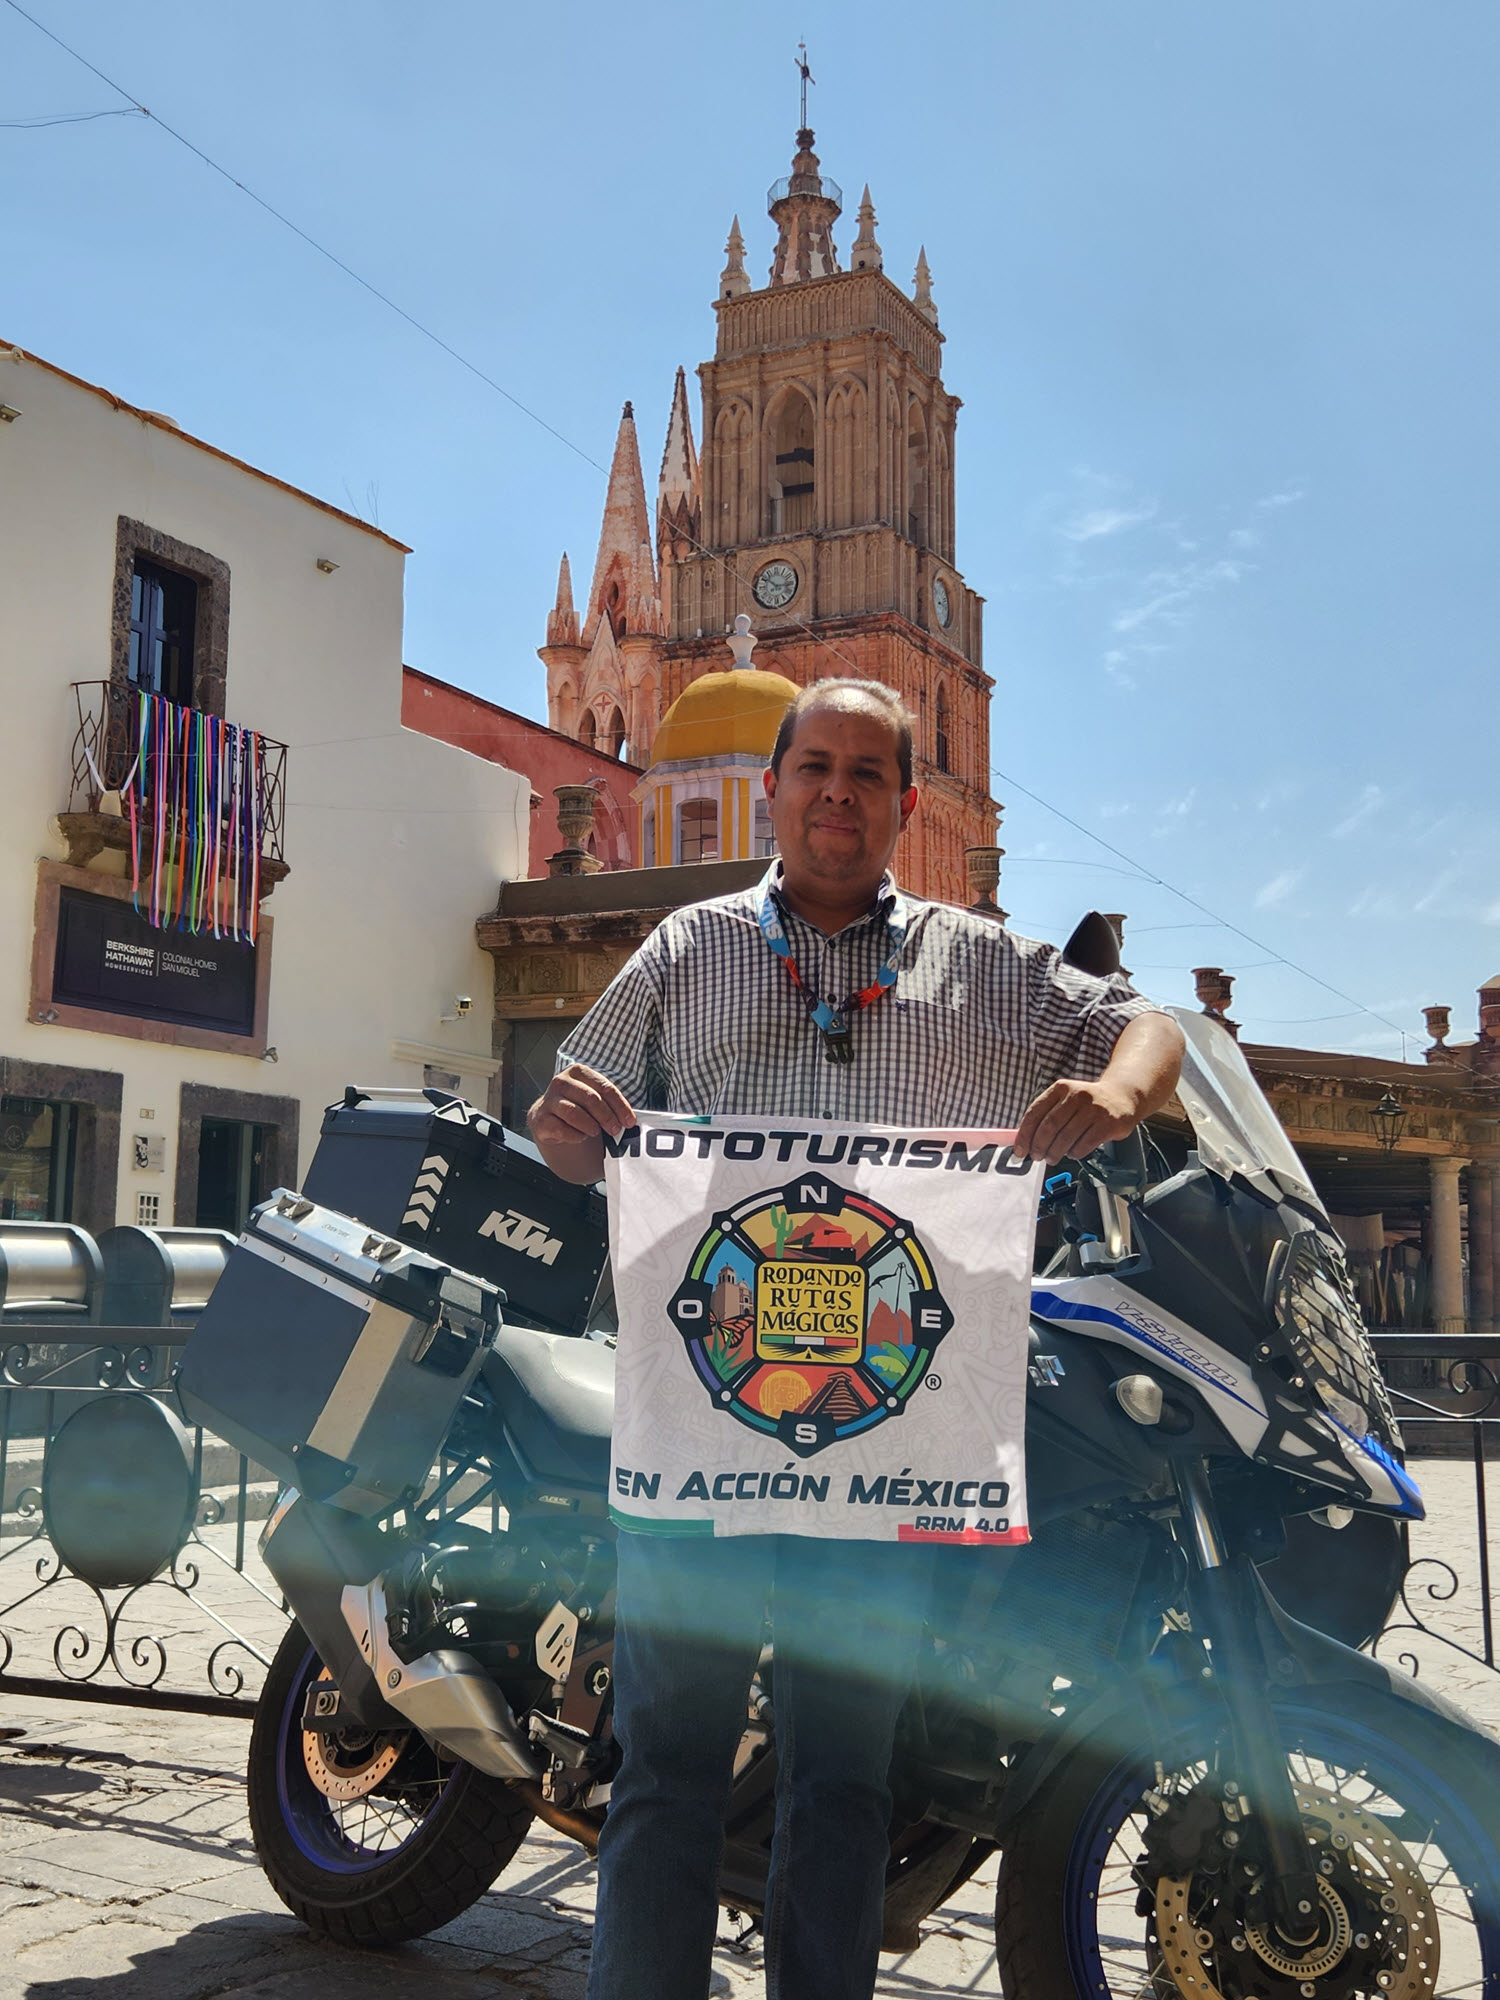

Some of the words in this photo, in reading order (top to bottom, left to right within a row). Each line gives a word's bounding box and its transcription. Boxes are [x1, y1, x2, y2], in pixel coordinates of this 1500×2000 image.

[106, 940, 155, 958] BERKSHIRE
[105, 950, 154, 968] HATHAWAY
[162, 952, 195, 966] COLONIAL
[194, 959, 217, 971] HOMES
[162, 962, 176, 973] SAN
[175, 965, 200, 978] MIGUEL
[602, 1125, 1034, 1176] MOTOTURISMO
[801, 1185, 828, 1204] N
[478, 1209, 564, 1266] KTM
[677, 1299, 703, 1319] O
[920, 1309, 942, 1328] E
[1122, 1320, 1145, 1336] SPORT
[1144, 1334, 1183, 1361] ADVENTURE
[1183, 1361, 1211, 1380] TOURER
[794, 1423, 817, 1443] S
[616, 1467, 662, 1499] EN
[676, 1462, 831, 1502] ACCIÓN
[849, 1468, 1010, 1509] MÉXICO
[915, 1516, 966, 1532] RRM
[974, 1518, 1010, 1532] 4.0
